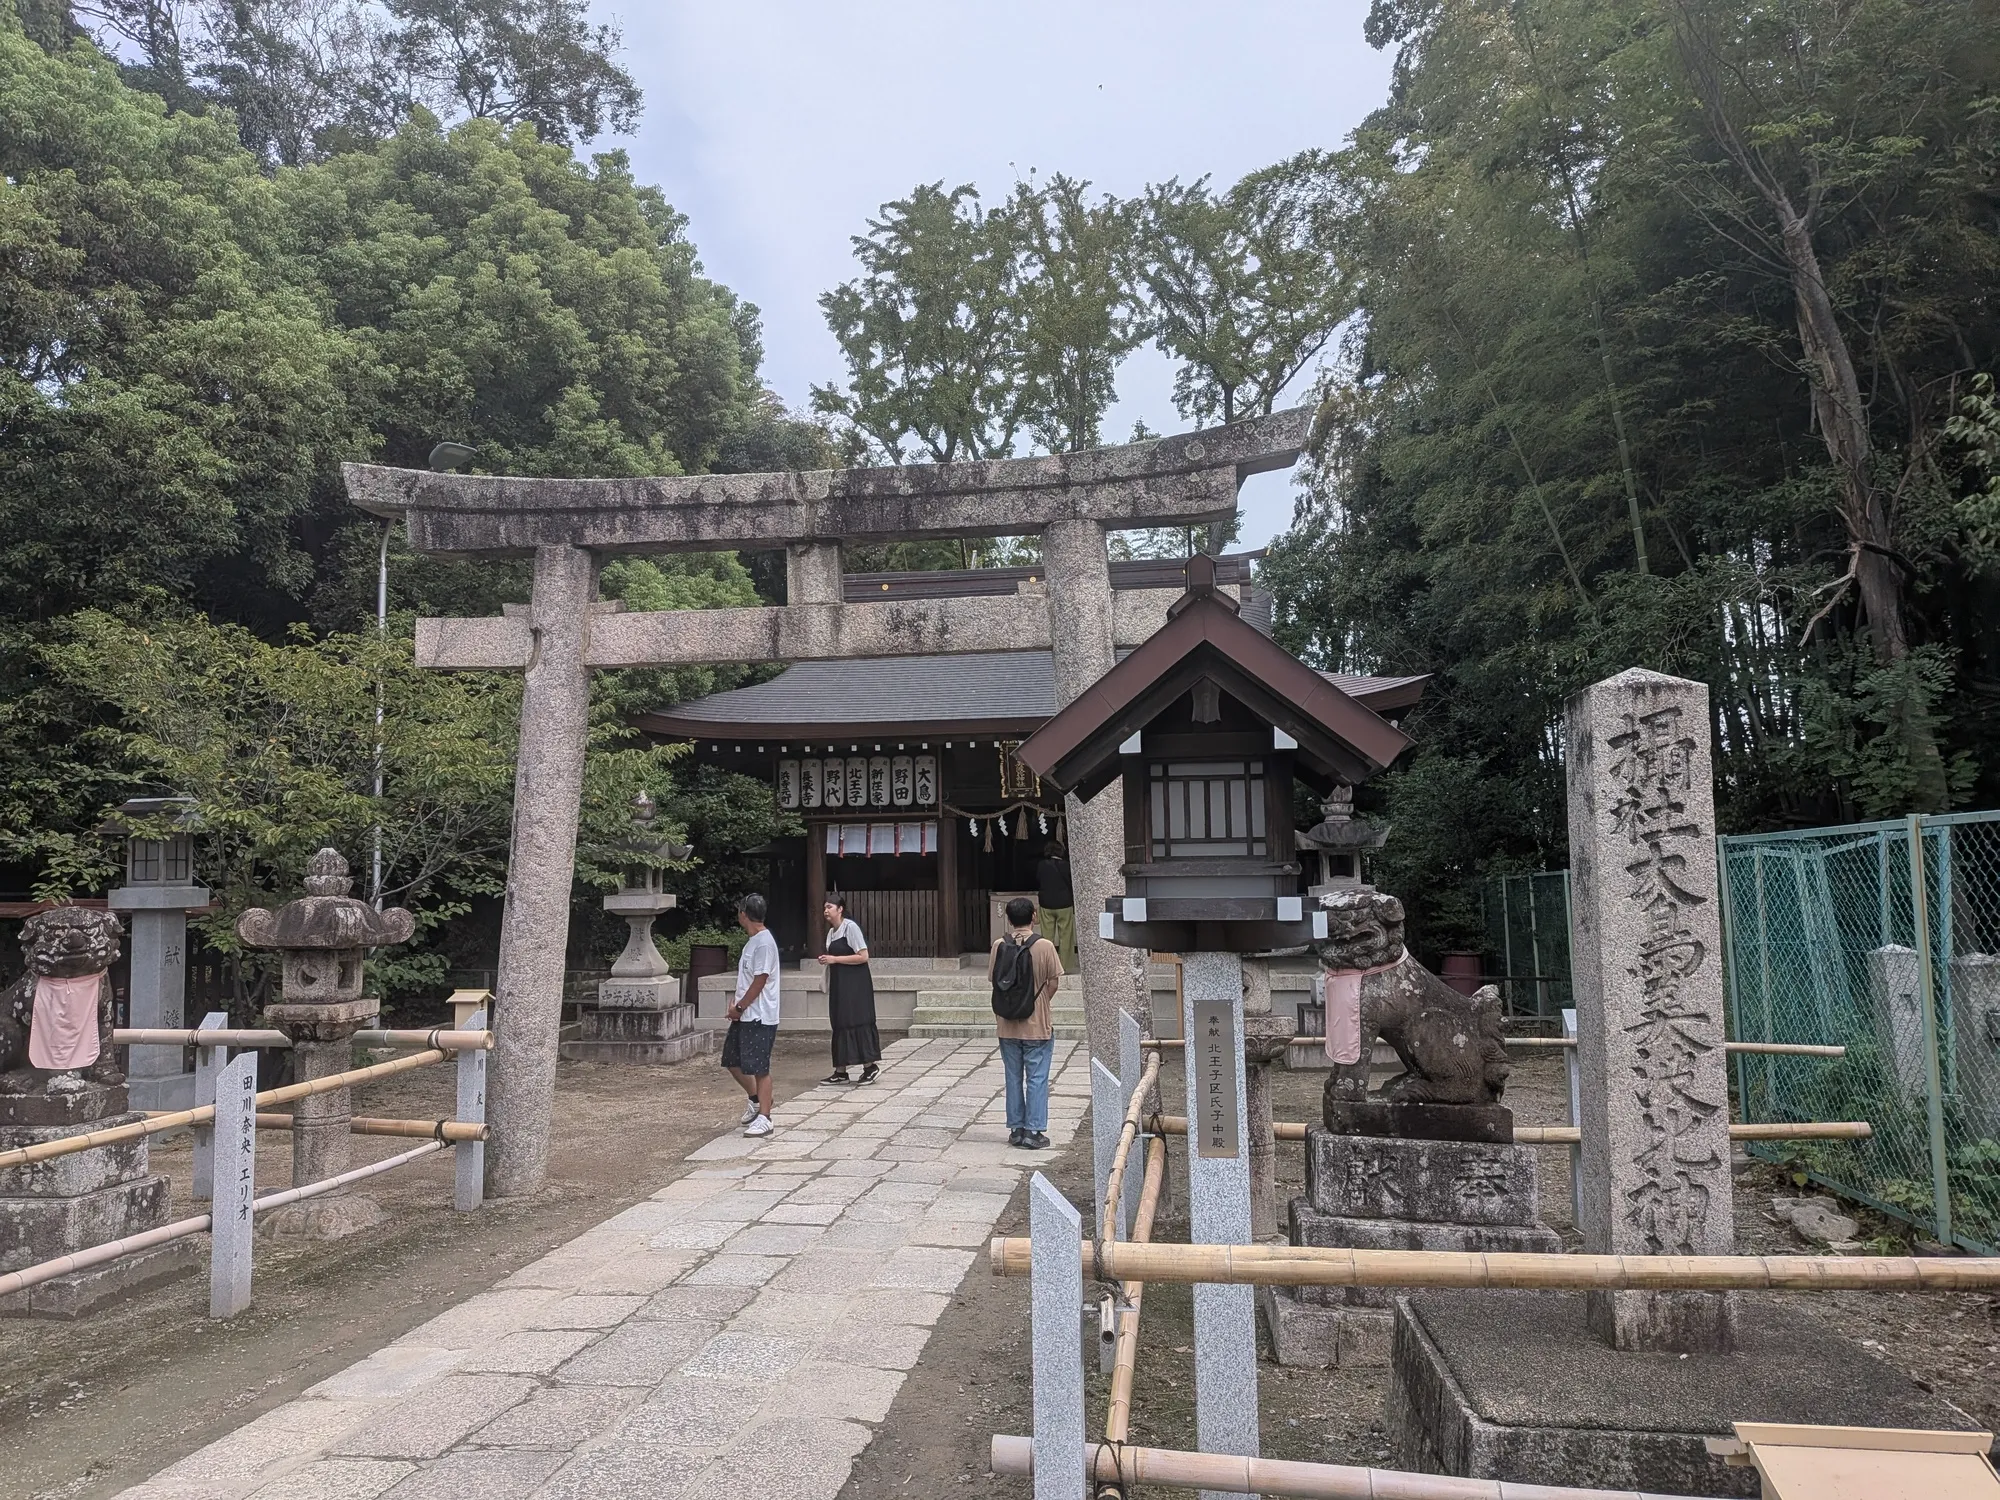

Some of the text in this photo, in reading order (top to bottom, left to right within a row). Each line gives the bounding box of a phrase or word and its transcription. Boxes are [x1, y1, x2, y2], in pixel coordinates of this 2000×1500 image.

[825, 769, 842, 804] 野代
[848, 767, 863, 804] 北王子
[894, 767, 910, 801] 野田
[917, 767, 932, 802] 大鳥
